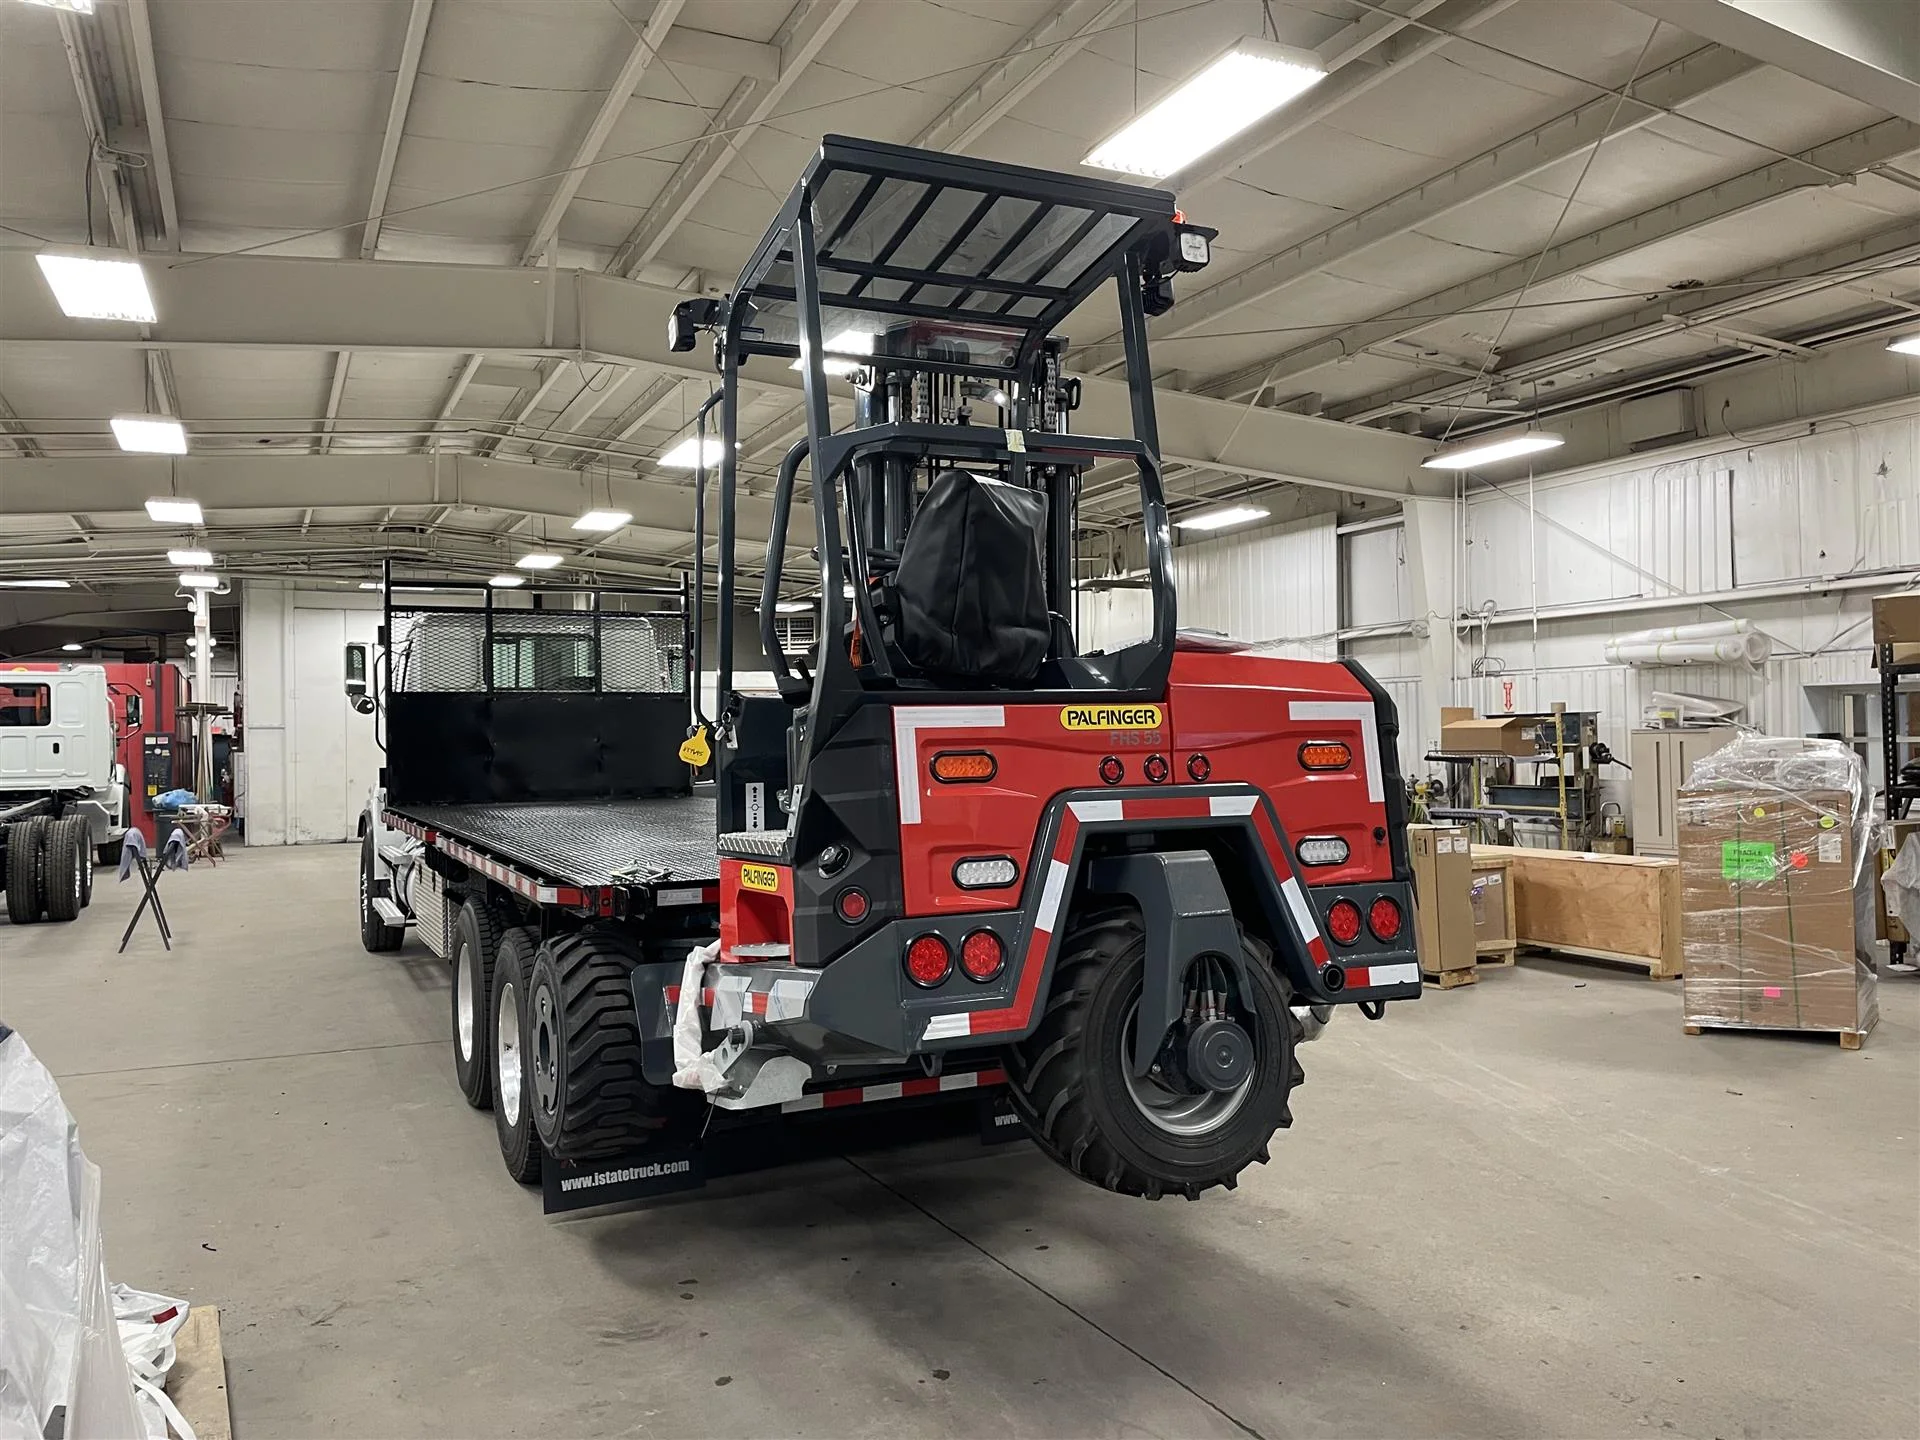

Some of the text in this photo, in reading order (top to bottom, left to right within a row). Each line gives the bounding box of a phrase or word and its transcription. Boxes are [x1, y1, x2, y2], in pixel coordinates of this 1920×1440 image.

[1067, 709, 1156, 726] PALFINGER
[1110, 730, 1162, 746] FHS 55
[743, 868, 776, 888] PALFINGER
[561, 1160, 690, 1192] www.istatetruck.com
